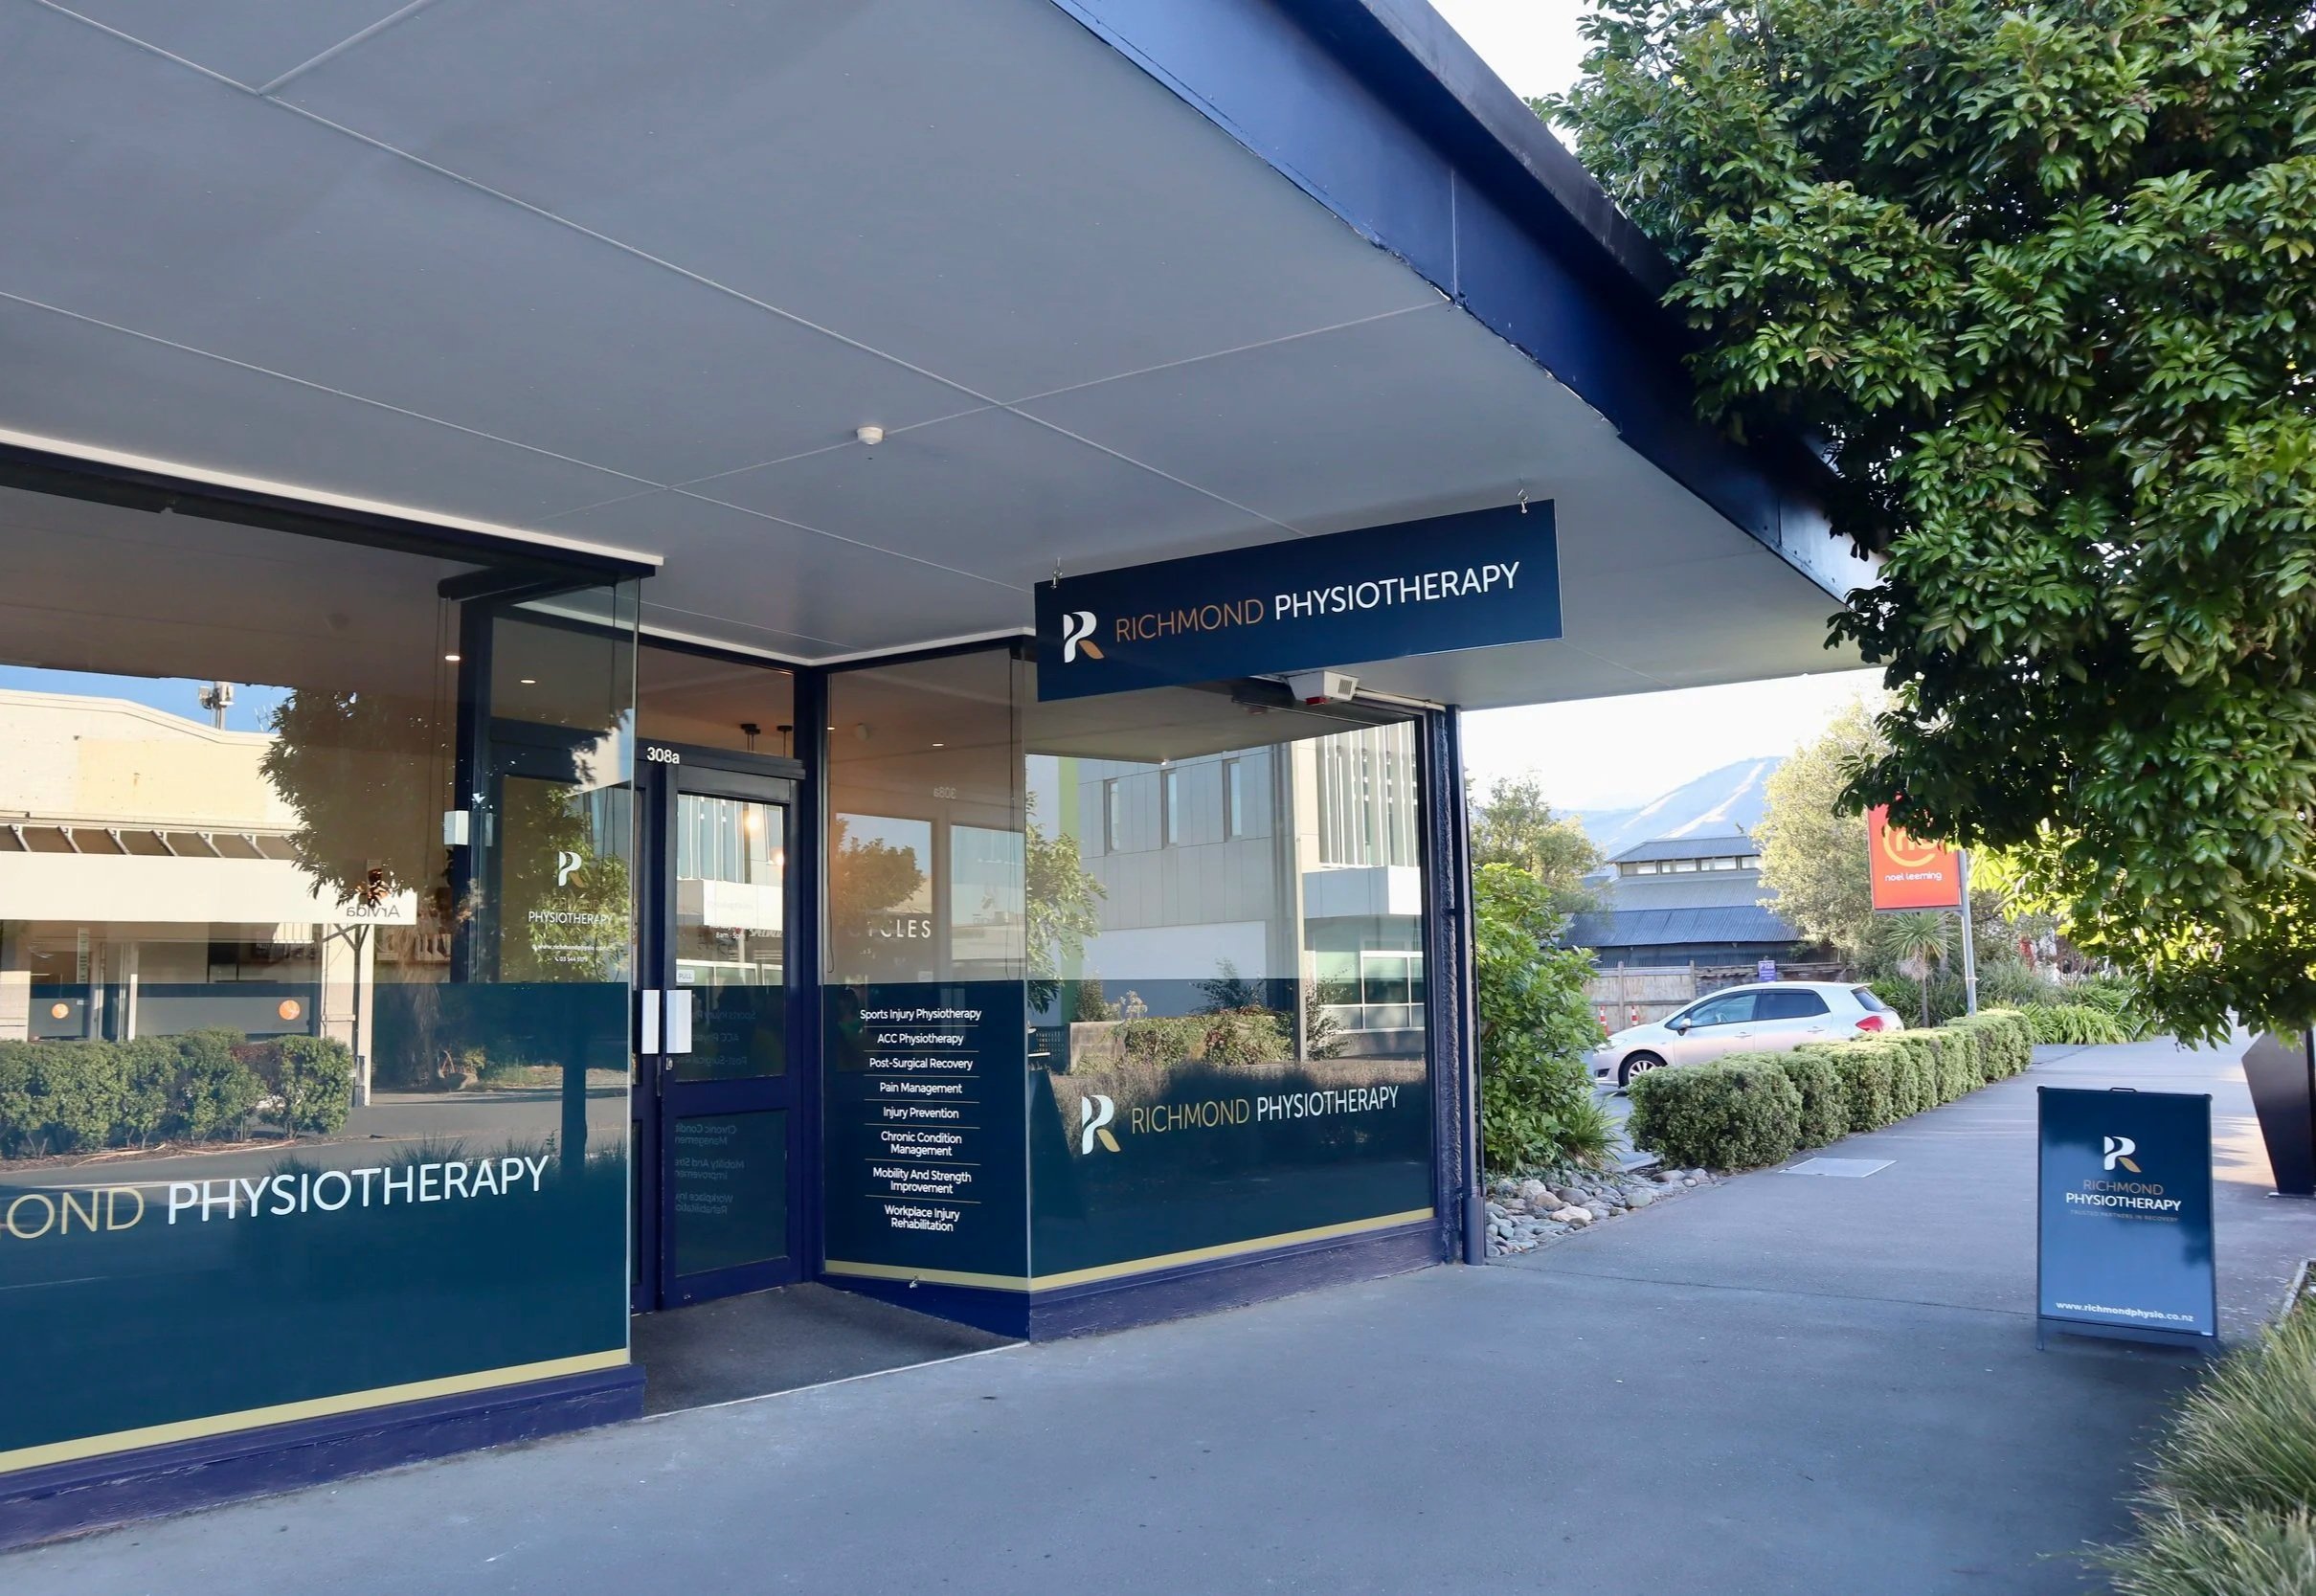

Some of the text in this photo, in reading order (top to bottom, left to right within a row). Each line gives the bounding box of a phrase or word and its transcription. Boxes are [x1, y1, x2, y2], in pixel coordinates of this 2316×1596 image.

[1116, 561, 1520, 642] RICHMOND PHYSIOTHERAPY
[646, 746, 680, 764] 308a
[1884, 870, 1943, 882] noel leeming
[528, 910, 613, 925] PHYSIOTHERAPY
[860, 1008, 981, 1022] Sports Injury Physiotherapy
[877, 1033, 963, 1045] ACC Physiotherapy
[869, 1058, 973, 1070] Post-Surgical Recovery
[880, 1083, 962, 1095] Pain Management
[883, 1107, 959, 1119] Injury Prevention
[1132, 1086, 1399, 1135] RICHMOND PHYSIOTHERAPY
[881, 1131, 962, 1144] Chronic Condition
[890, 1144, 953, 1158] Management
[873, 1167, 972, 1184] Mobility And Strength
[168, 1154, 550, 1225] PHYSIOTHERAPY
[890, 1180, 954, 1195] Improvement
[2083, 1180, 2164, 1196] RICHMOND
[2066, 1193, 2181, 1211] PHYSIOTHERAPY
[885, 1204, 960, 1222] Workplace Injury
[2101, 1211, 2133, 1220] PARTNERS
[890, 1218, 954, 1232] Rehabilitation
[2056, 1302, 2194, 1322] www.richmondphysio.co.nz
